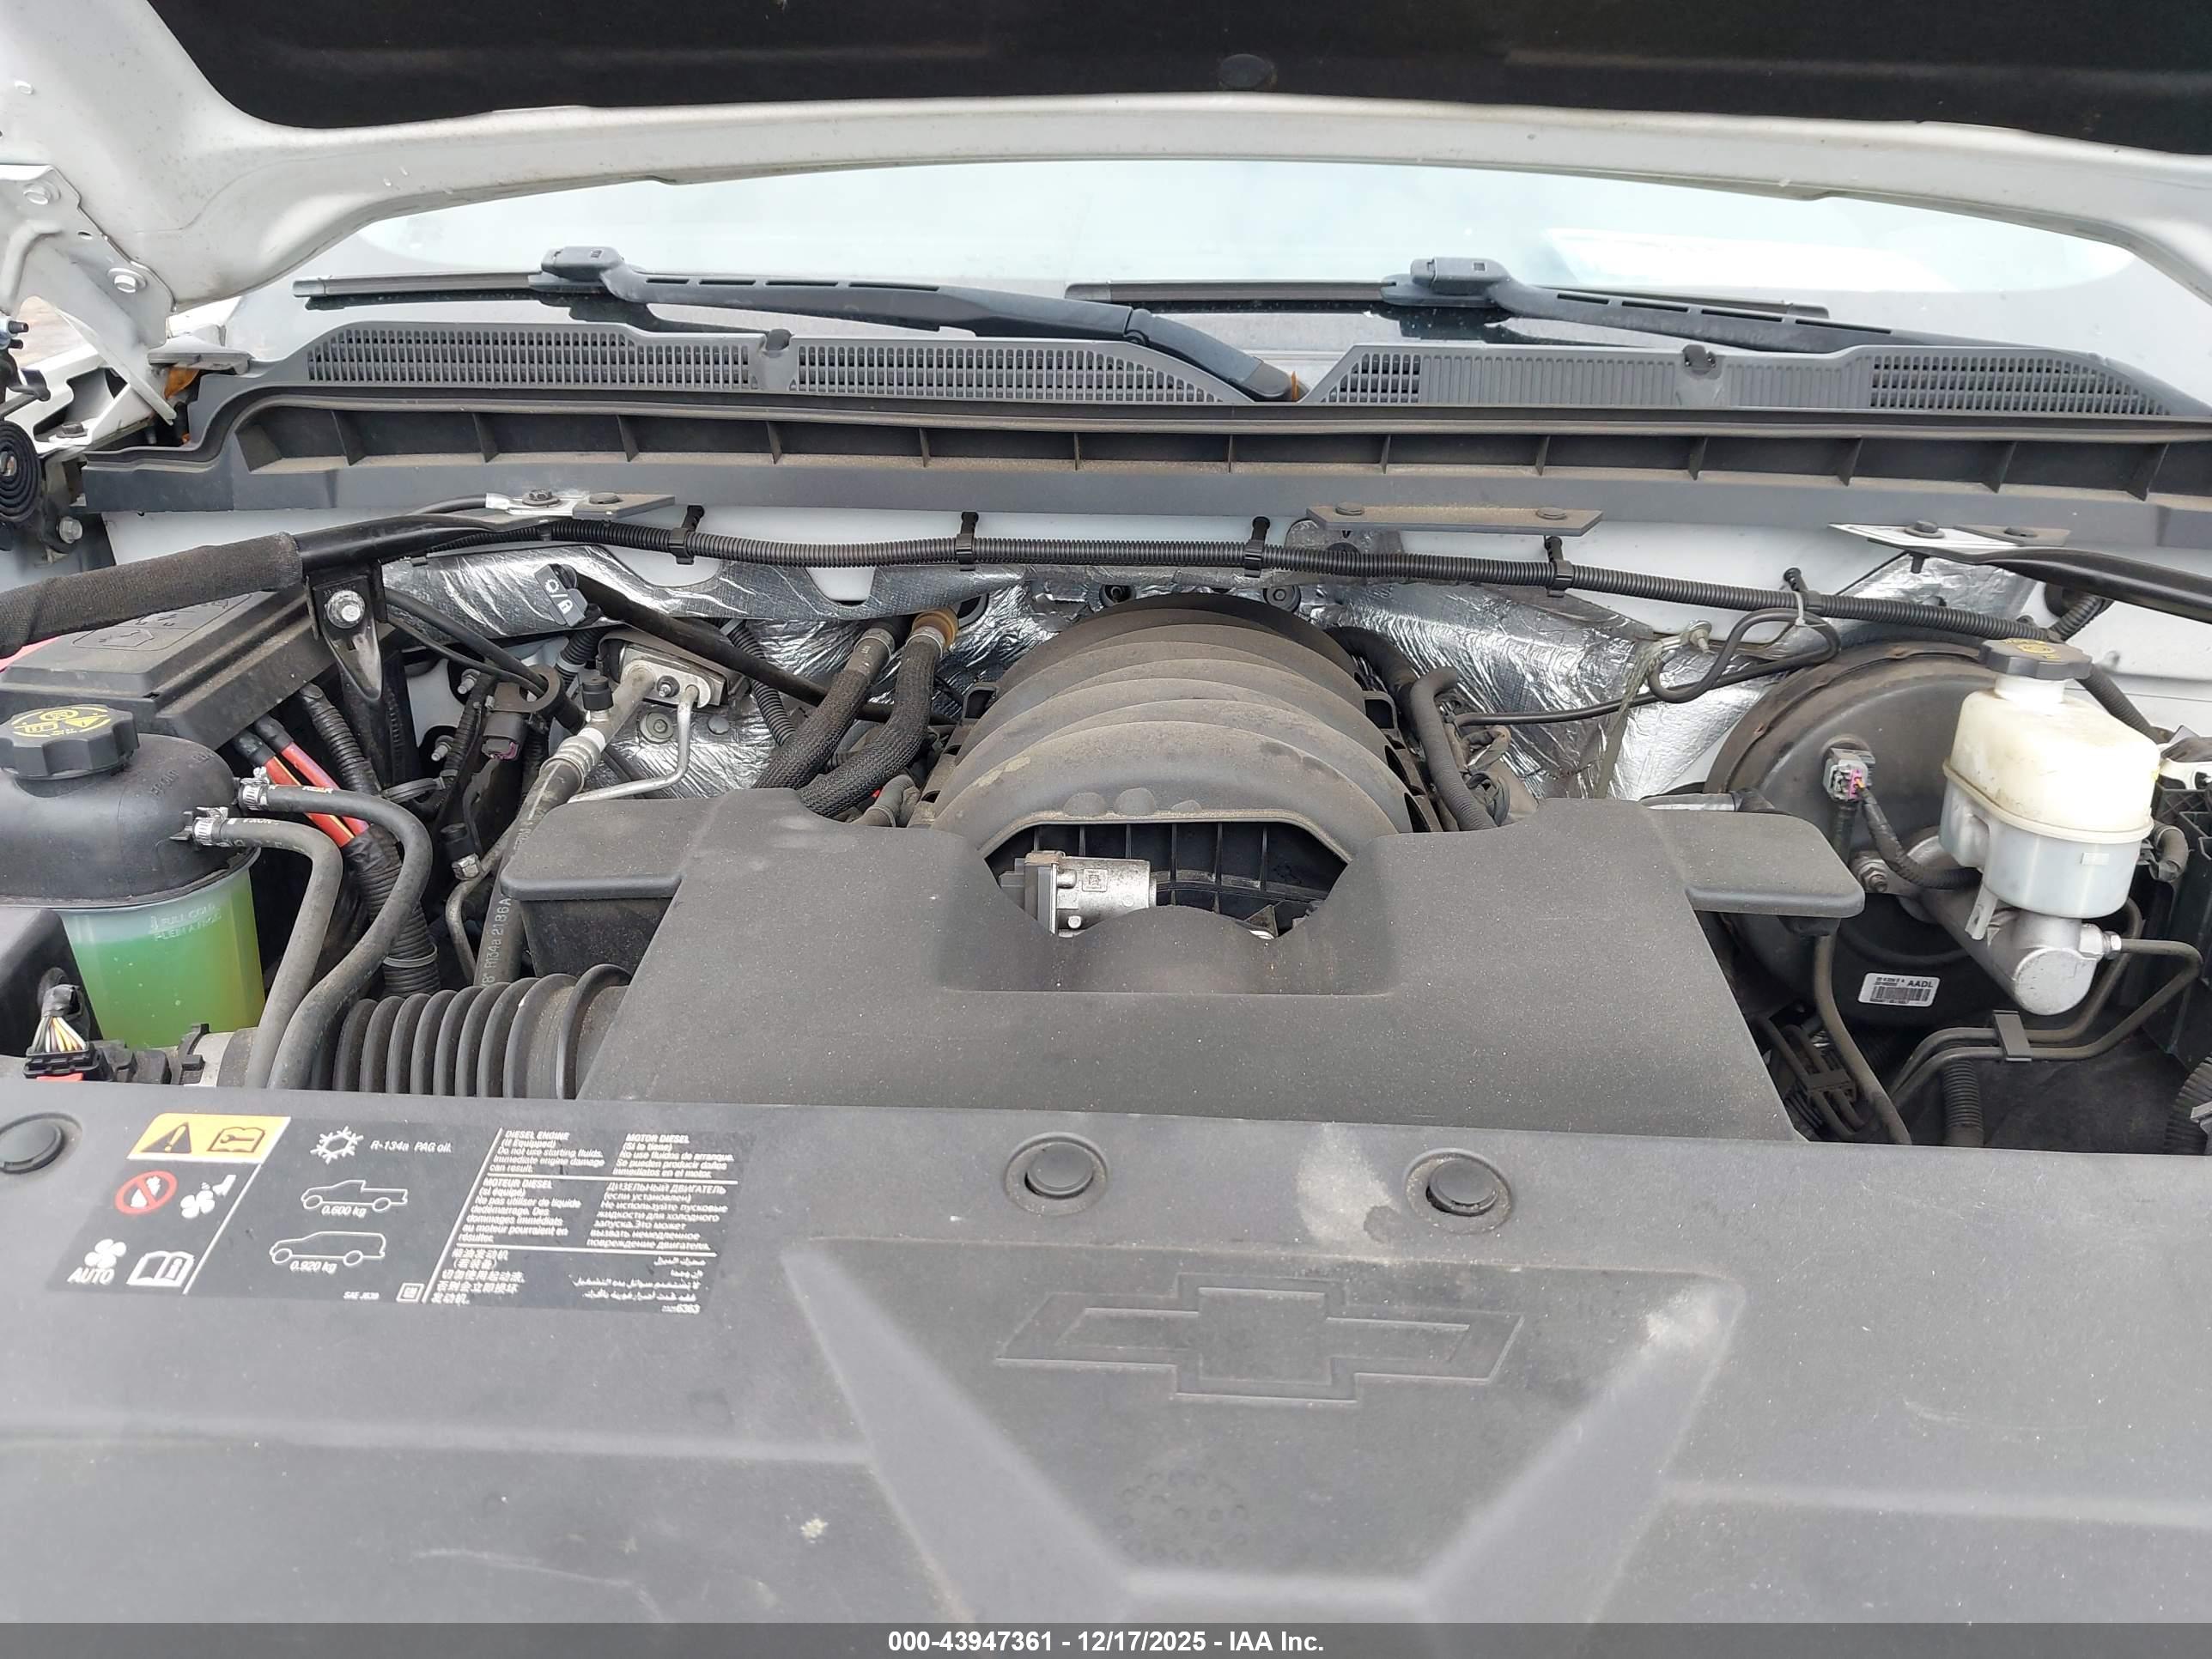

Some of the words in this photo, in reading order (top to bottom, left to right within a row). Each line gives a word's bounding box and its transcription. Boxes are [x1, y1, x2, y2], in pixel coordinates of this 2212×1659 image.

[490, 896, 513, 936] 2186A
[483, 939, 503, 969] R134a
[1906, 980, 1935, 988] AADL
[505, 1130, 536, 1139] DIESEL
[537, 1131, 570, 1141] ENGINE
[625, 1133, 659, 1143] MOTOR
[659, 1134, 690, 1144] DIESEL
[370, 1139, 410, 1152] R-134a
[414, 1141, 436, 1153] PAG
[511, 1147, 525, 1156] not
[544, 1149, 576, 1159] starting
[619, 1150, 633, 1159] No
[651, 1151, 680, 1161] fluidos
[681, 1152, 693, 1161] de
[494, 1155, 538, 1164] Immediate
[539, 1158, 568, 1167] engine
[570, 1158, 605, 1168] damage
[616, 1158, 629, 1168] Se
[629, 1159, 662, 1169] pueden
[663, 1159, 701, 1170] producir
[701, 1160, 728, 1171] daños
[489, 1164, 506, 1173] can
[612, 1167, 660, 1176] inmediatos
[674, 1169, 685, 1178] el
[483, 1177, 521, 1188] MOTEUR
[522, 1179, 553, 1189] DIESEL
[606, 1181, 670, 1192] ДИЗЕЛЬНЫЙ
[670, 1183, 727, 1195] ДВИГАТЕЛЬ
[604, 1191, 631, 1200] (если
[475, 1195, 488, 1206] Ne
[488, 1197, 506, 1206] pas
[507, 1197, 538, 1206] utiliser
[538, 1198, 550, 1207] de
[551, 1197, 582, 1209] liquide
[600, 1200, 616, 1210] Не
[321, 1206, 351, 1217] 0.600
[352, 1206, 367, 1218] kg
[466, 1215, 515, 1225] dommages
[462, 1224, 475, 1233] au
[476, 1224, 508, 1234] moteur
[508, 1225, 555, 1237] pourraient
[289, 1261, 321, 1273] 0.920
[322, 1261, 337, 1274] kg
[67, 1267, 115, 1285] AUTO
